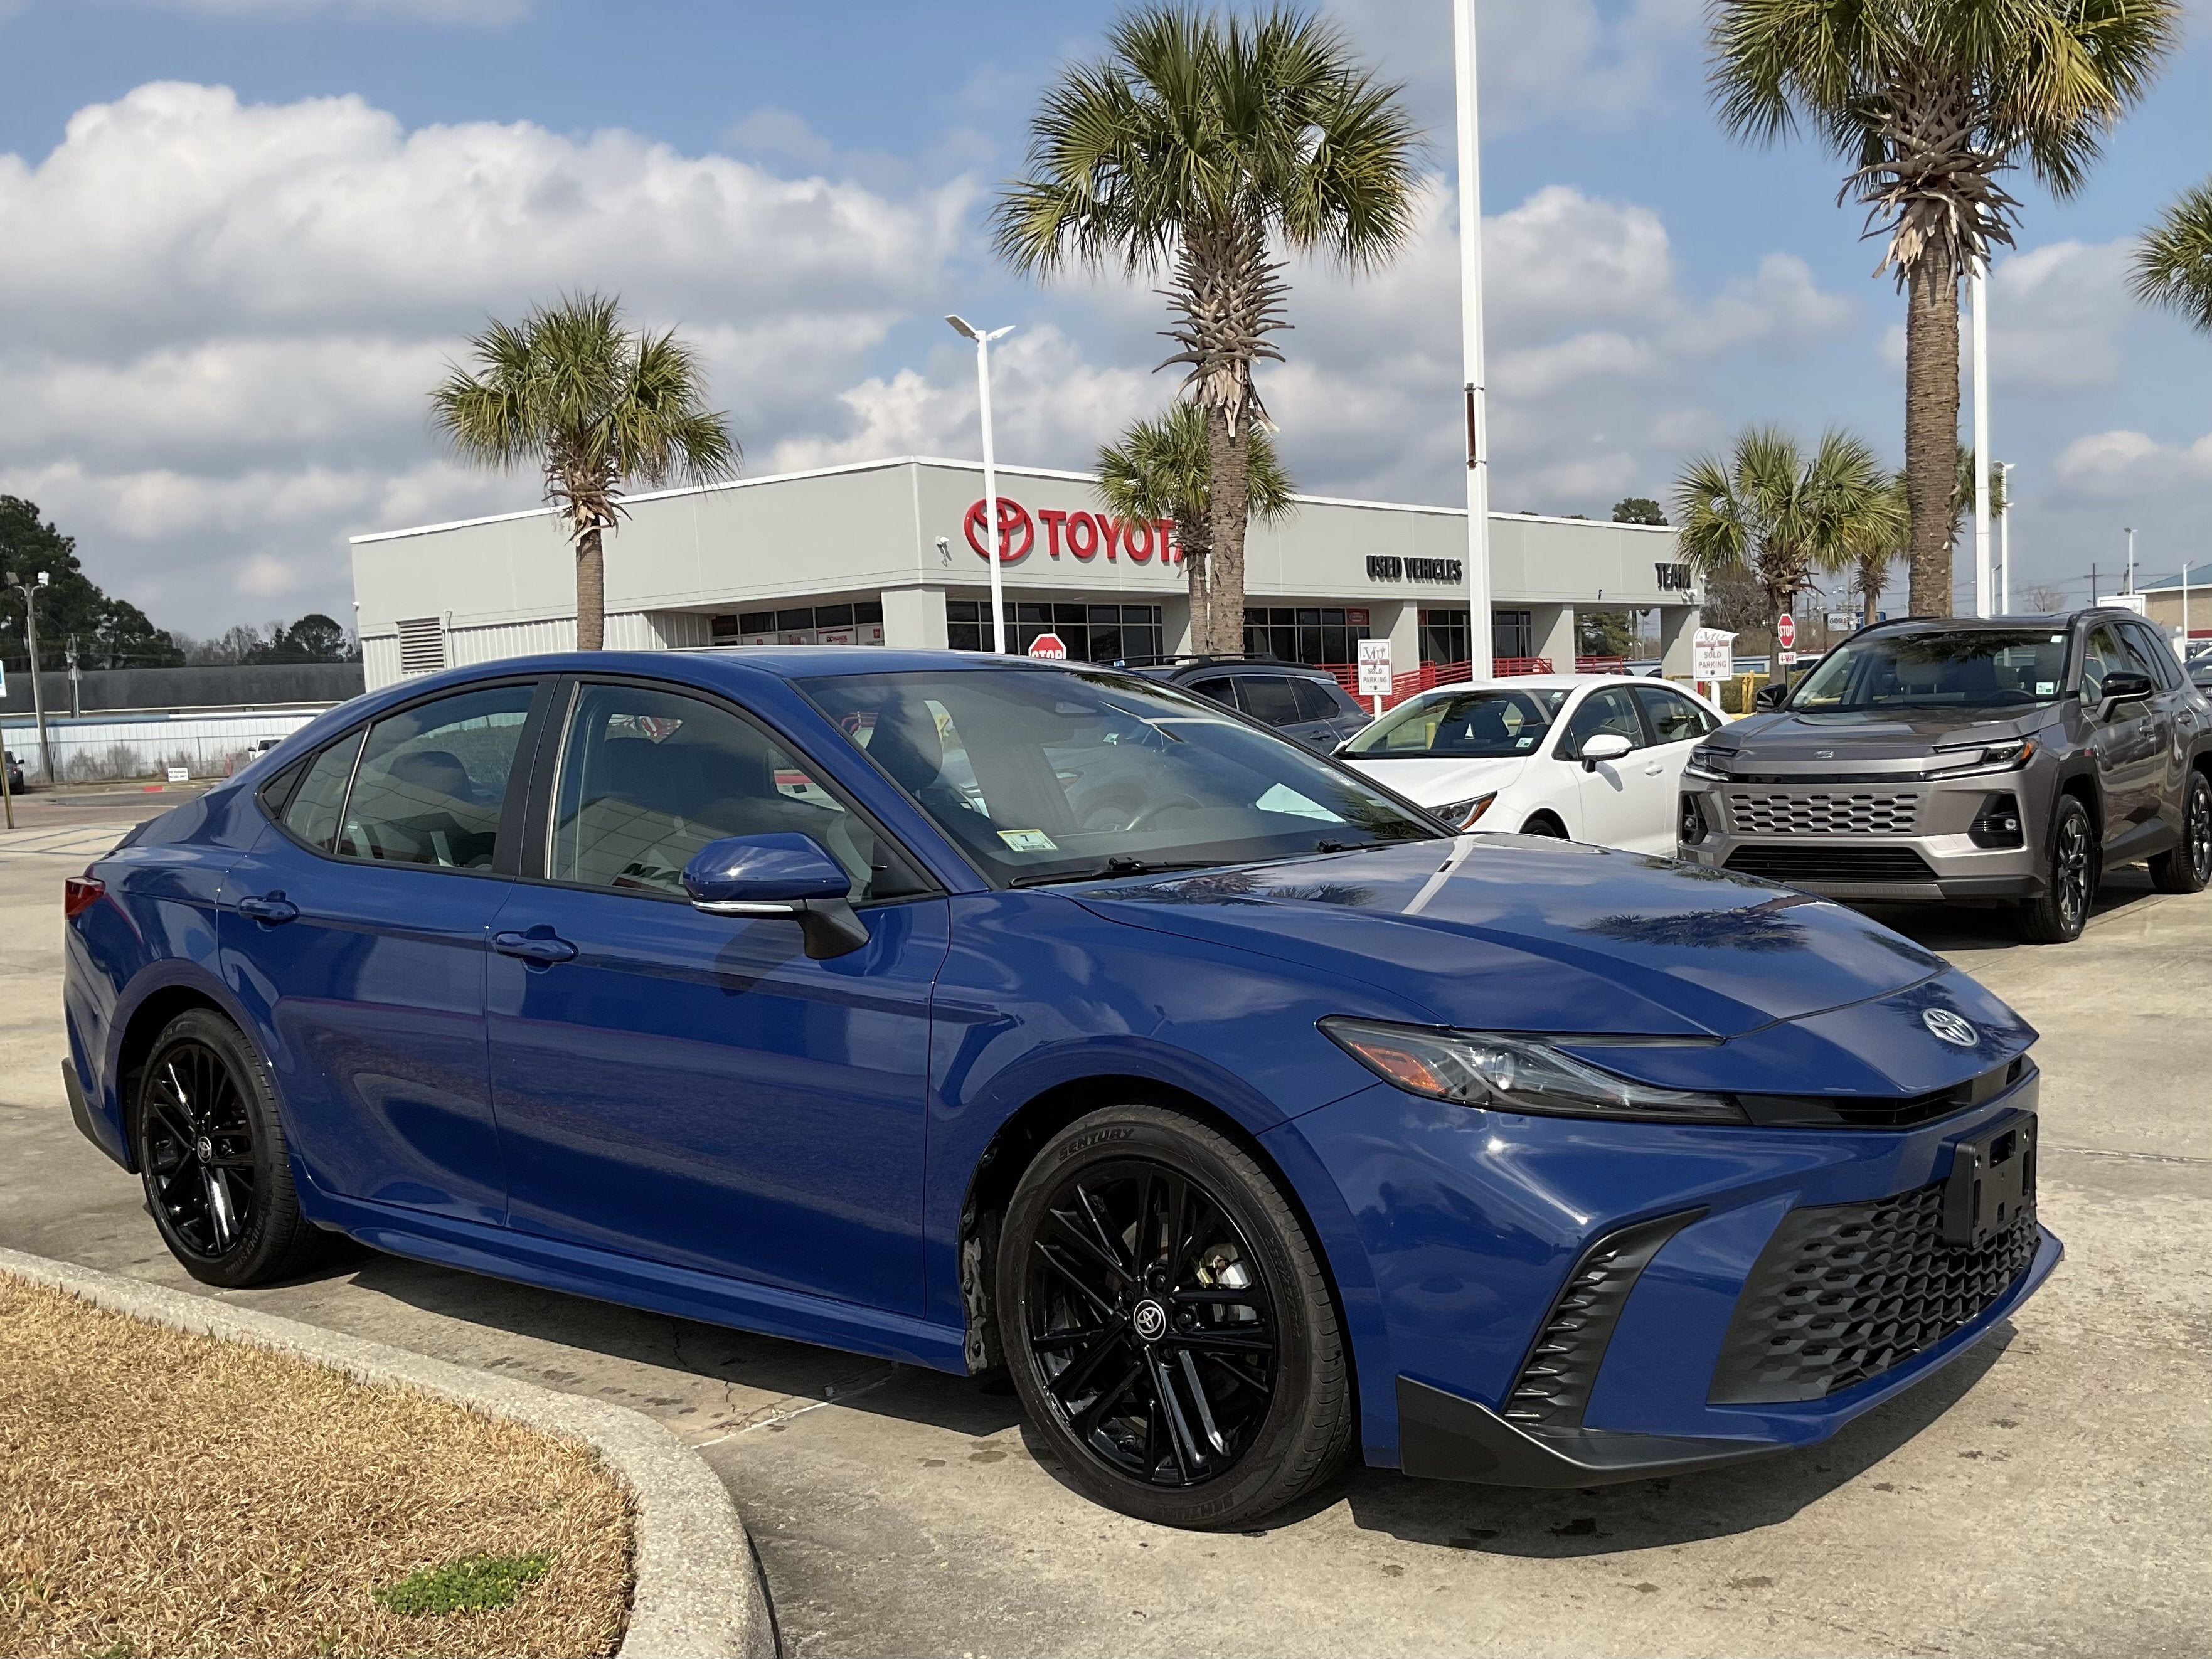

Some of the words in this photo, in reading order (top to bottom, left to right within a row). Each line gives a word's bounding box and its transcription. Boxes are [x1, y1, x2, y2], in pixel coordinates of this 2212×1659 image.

[1366, 555, 1402, 577] USED
[1403, 558, 1462, 580] VEHICLES
[1655, 563, 1691, 588] TEAM
[1779, 625, 1793, 637] STOP
[1059, 1128, 1135, 1162] SENTURY
